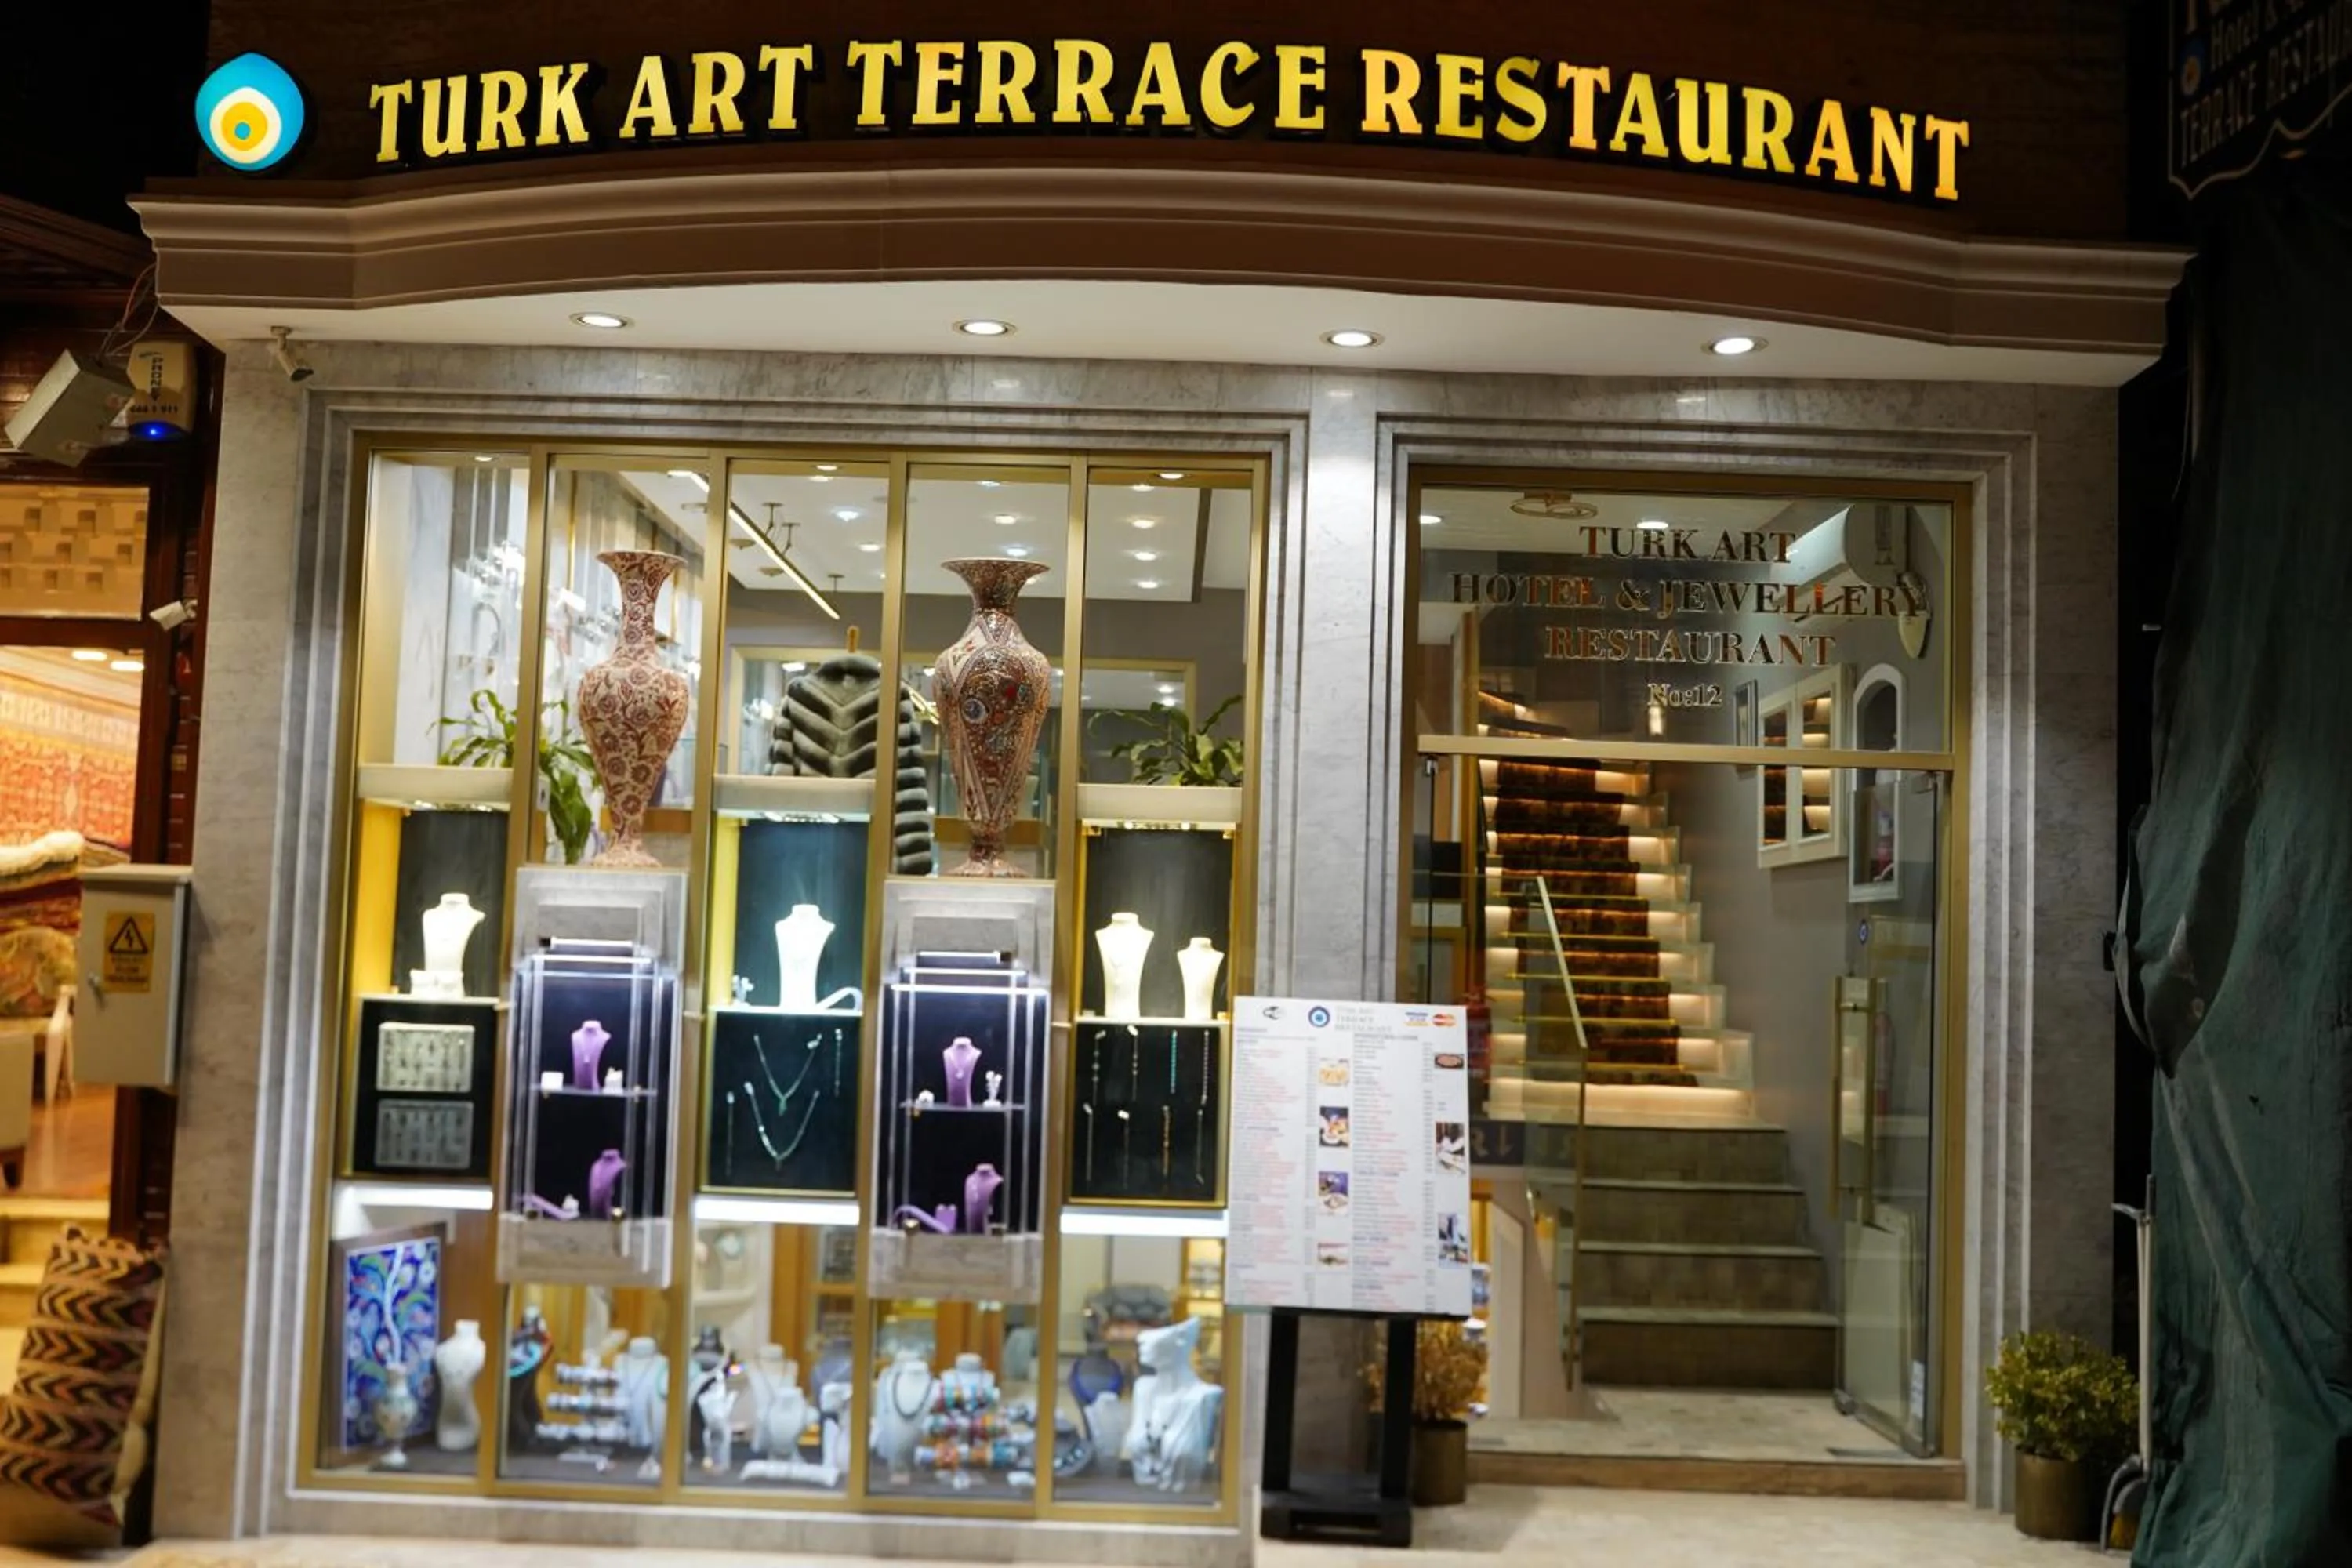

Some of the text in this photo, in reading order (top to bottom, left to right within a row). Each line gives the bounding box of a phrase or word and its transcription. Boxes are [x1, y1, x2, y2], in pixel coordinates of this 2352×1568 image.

[370, 39, 1970, 201] TURK ART TERRACE RESTAURANT
[1579, 526, 1796, 563] TURK ART
[1451, 573, 1930, 619] HOTEL & JEWELLERY
[1544, 626, 1836, 668] RESTAURANT
[1647, 682, 1722, 706] No:12
